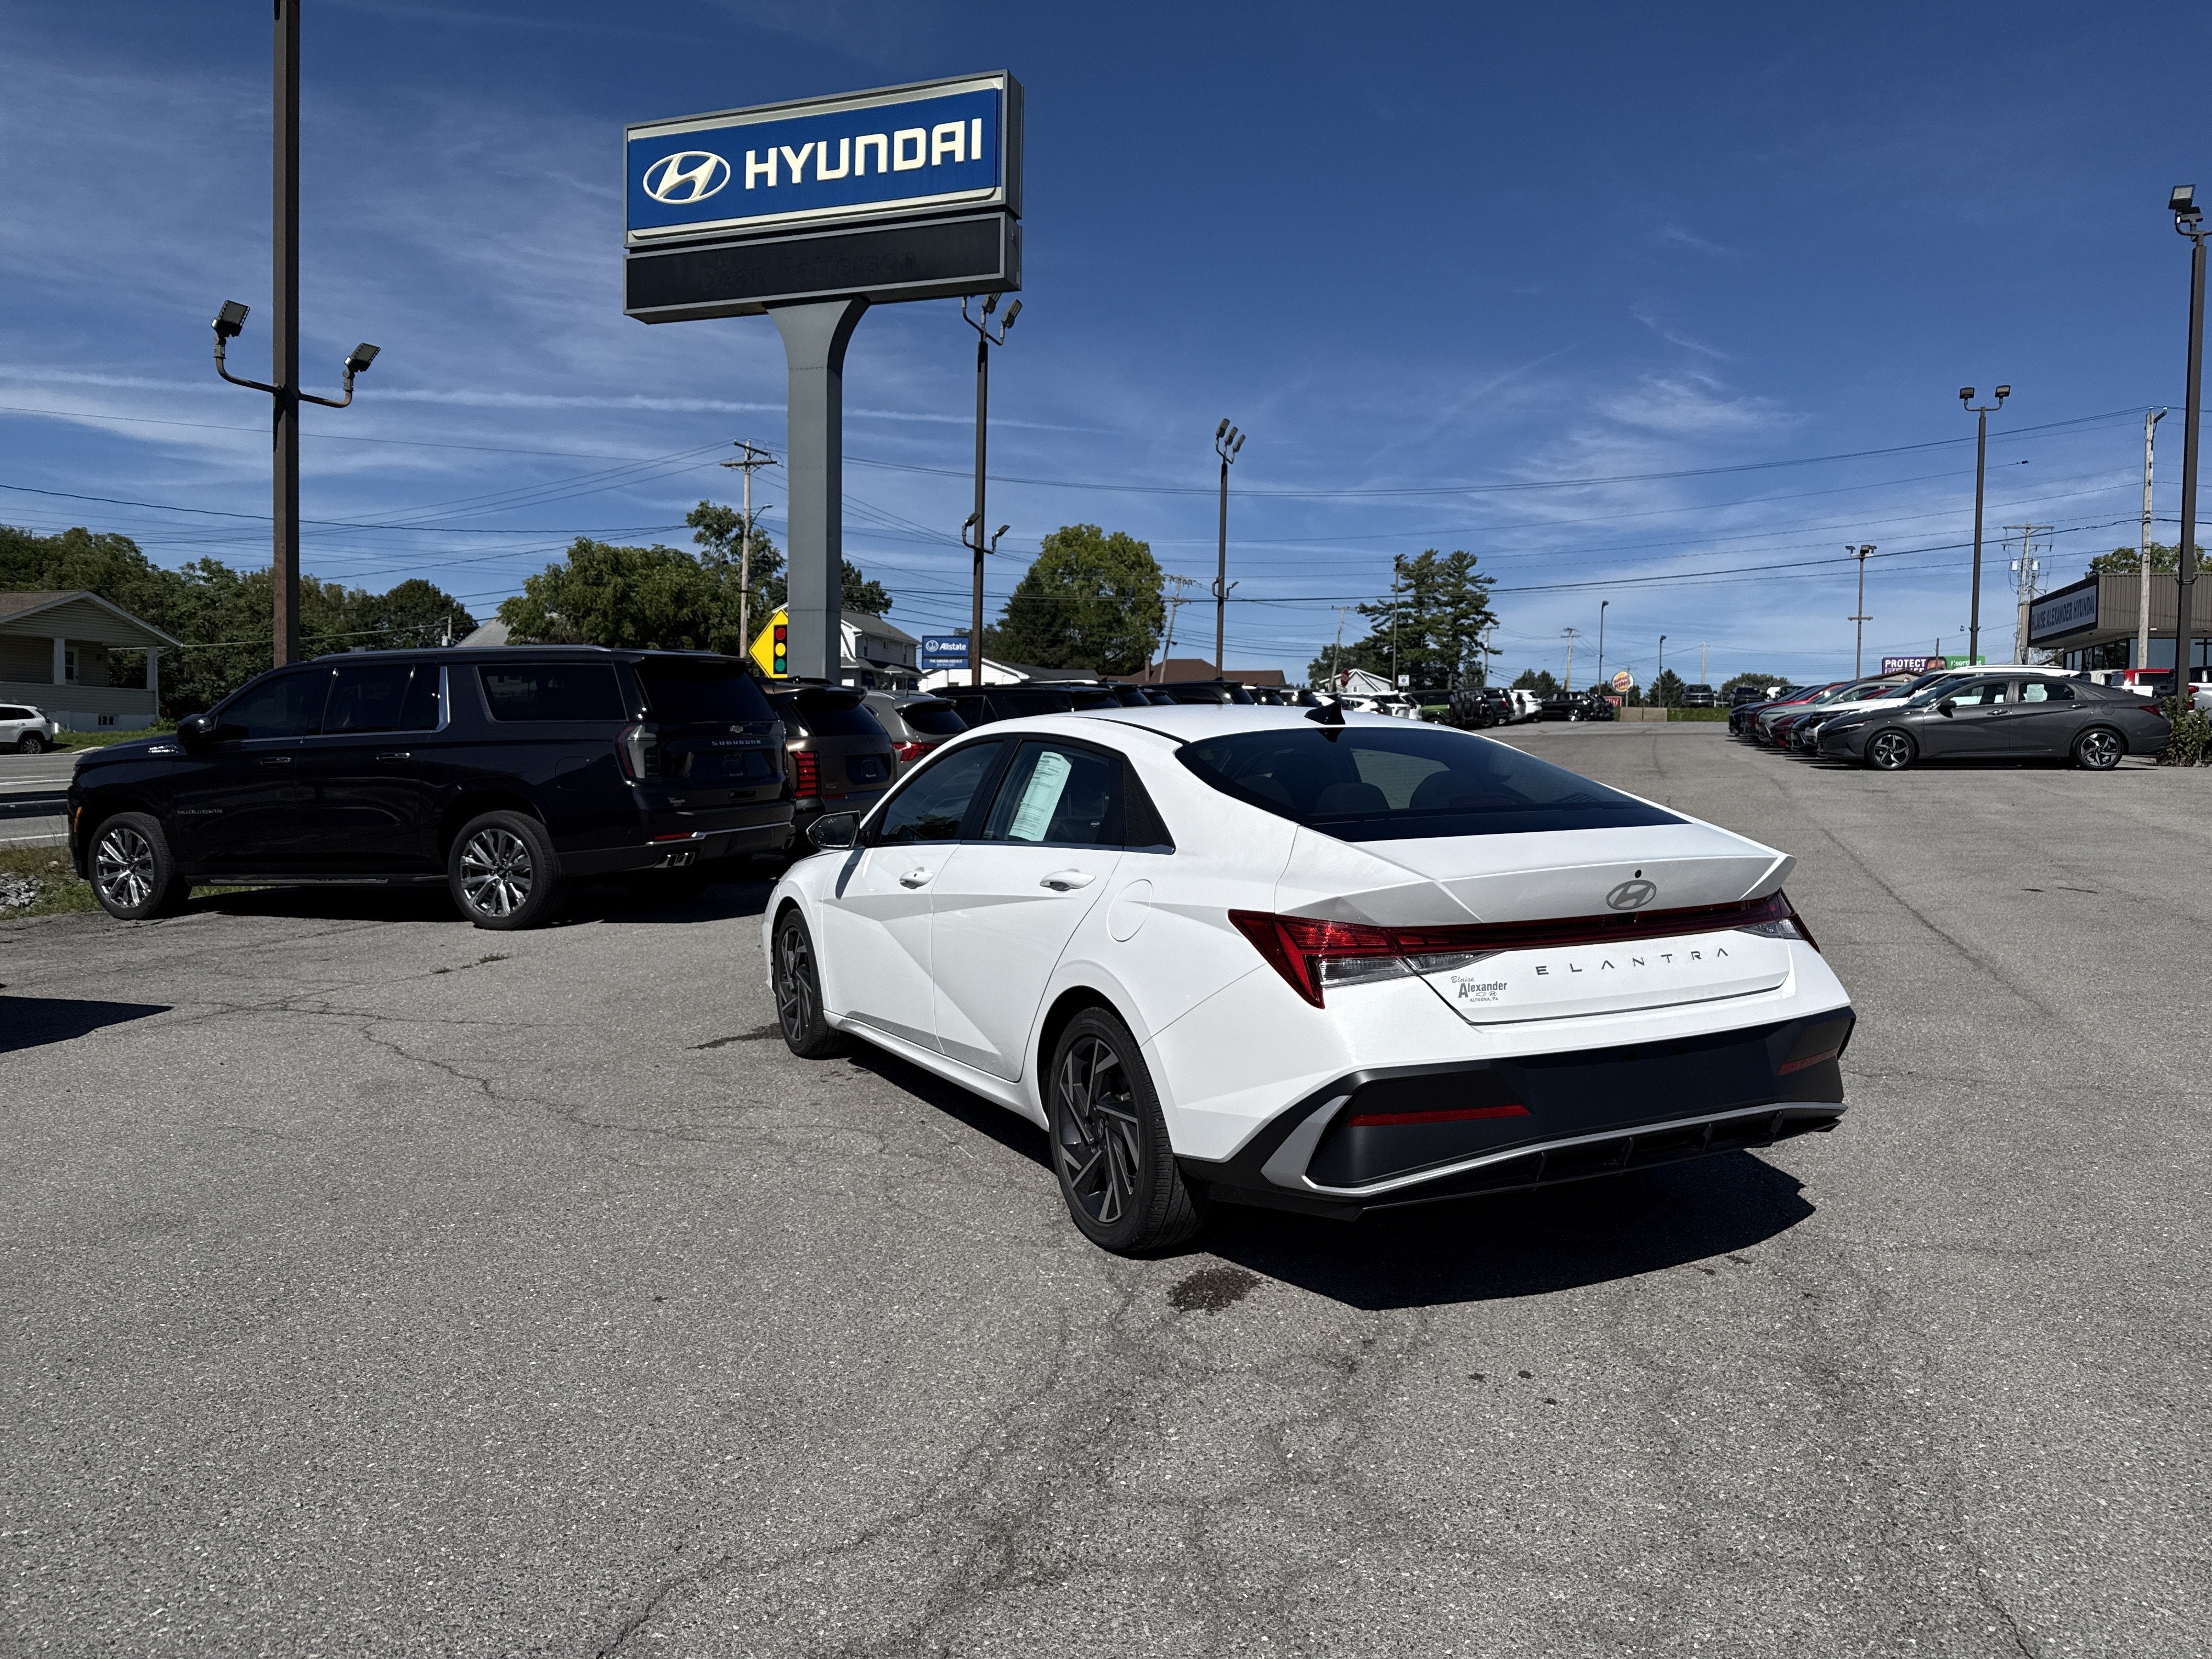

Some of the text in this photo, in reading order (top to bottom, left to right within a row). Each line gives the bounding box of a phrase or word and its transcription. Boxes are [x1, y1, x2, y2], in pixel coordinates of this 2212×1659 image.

[746, 118, 982, 189] HYUNDAI
[2032, 595, 2095, 631] BLAISE ALEXANDER HYUNDAI
[1885, 658, 1927, 668] PROTECT
[1536, 948, 1729, 975] ELANTRA
[1458, 981, 1508, 998] Alexander
